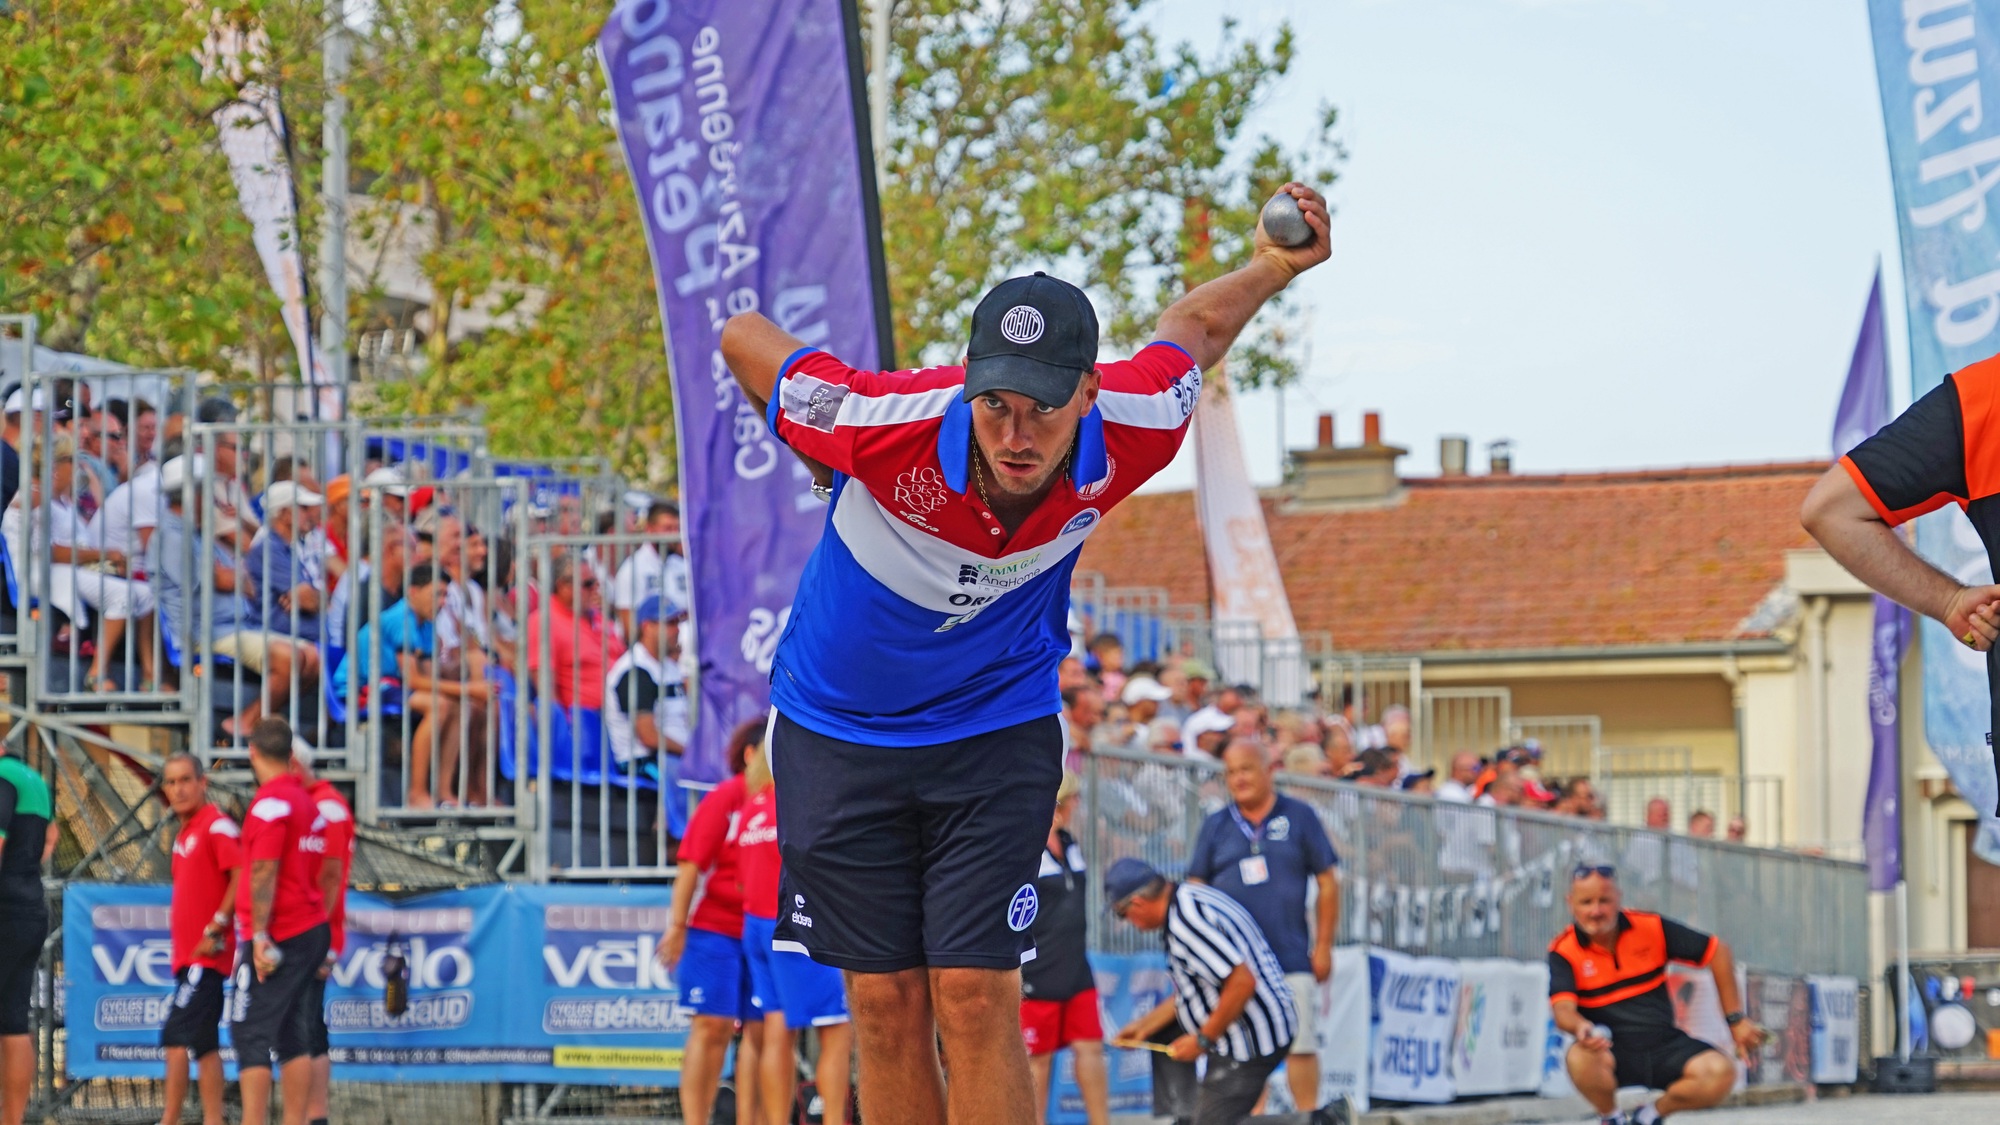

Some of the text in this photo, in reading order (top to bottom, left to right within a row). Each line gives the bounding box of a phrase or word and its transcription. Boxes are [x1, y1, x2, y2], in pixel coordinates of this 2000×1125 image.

[1009, 311, 1038, 338] OBUT
[897, 466, 943, 491] CLOS
[893, 486, 948, 514] ROSES
[911, 483, 933, 498] DES
[977, 563, 1017, 576] CIMM
[980, 568, 1041, 587] AnaHome
